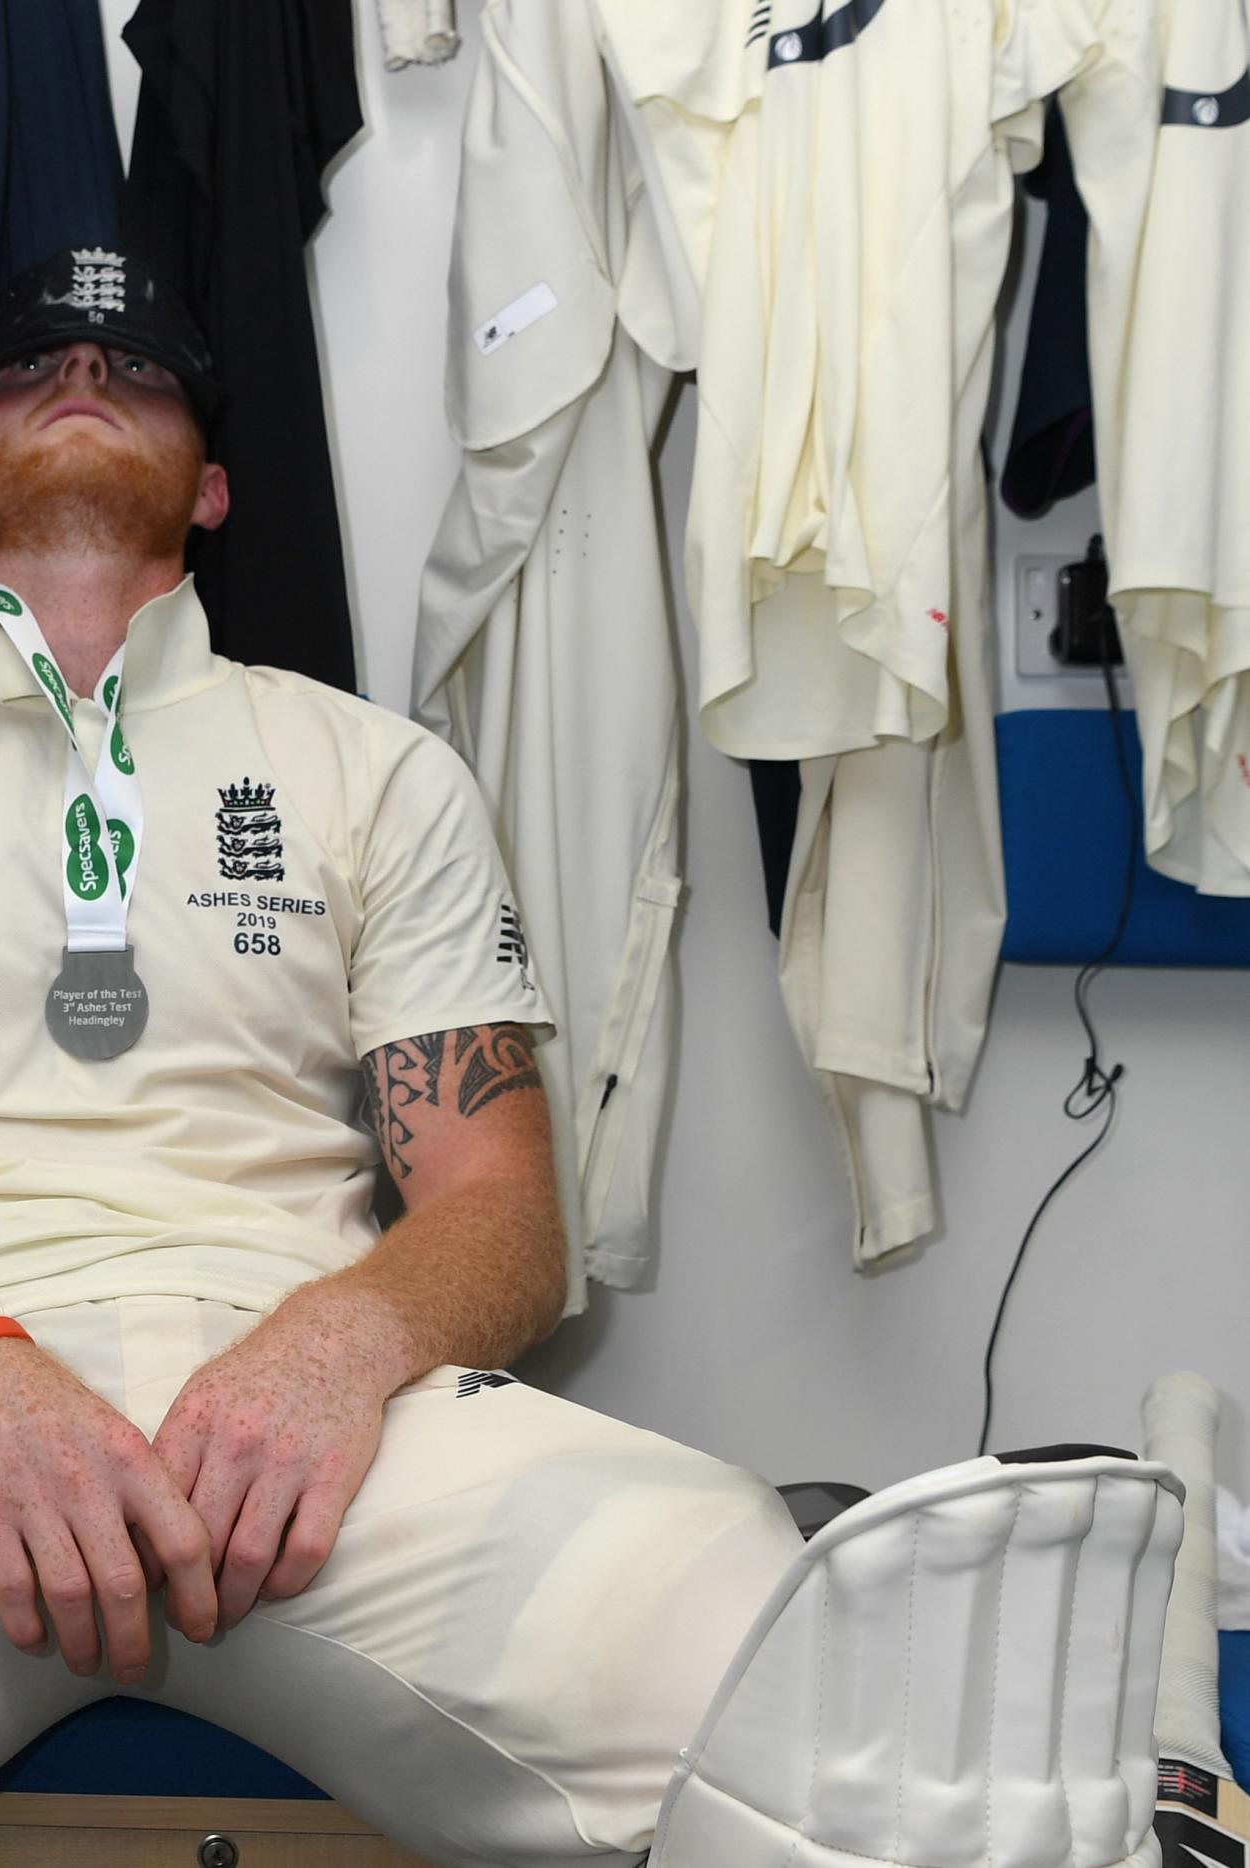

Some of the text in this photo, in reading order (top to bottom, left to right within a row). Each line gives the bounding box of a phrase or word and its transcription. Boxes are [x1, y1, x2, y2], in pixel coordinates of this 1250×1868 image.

[75, 802, 99, 892] Specsavers
[187, 892, 326, 916] ASHES SERIES
[236, 912, 277, 930] 2019
[233, 932, 282, 956] 658
[53, 988, 143, 1001] Player of the Test
[62, 1002, 132, 1013] 3rd Ashes Test
[68, 1015, 126, 1027] Headingley
